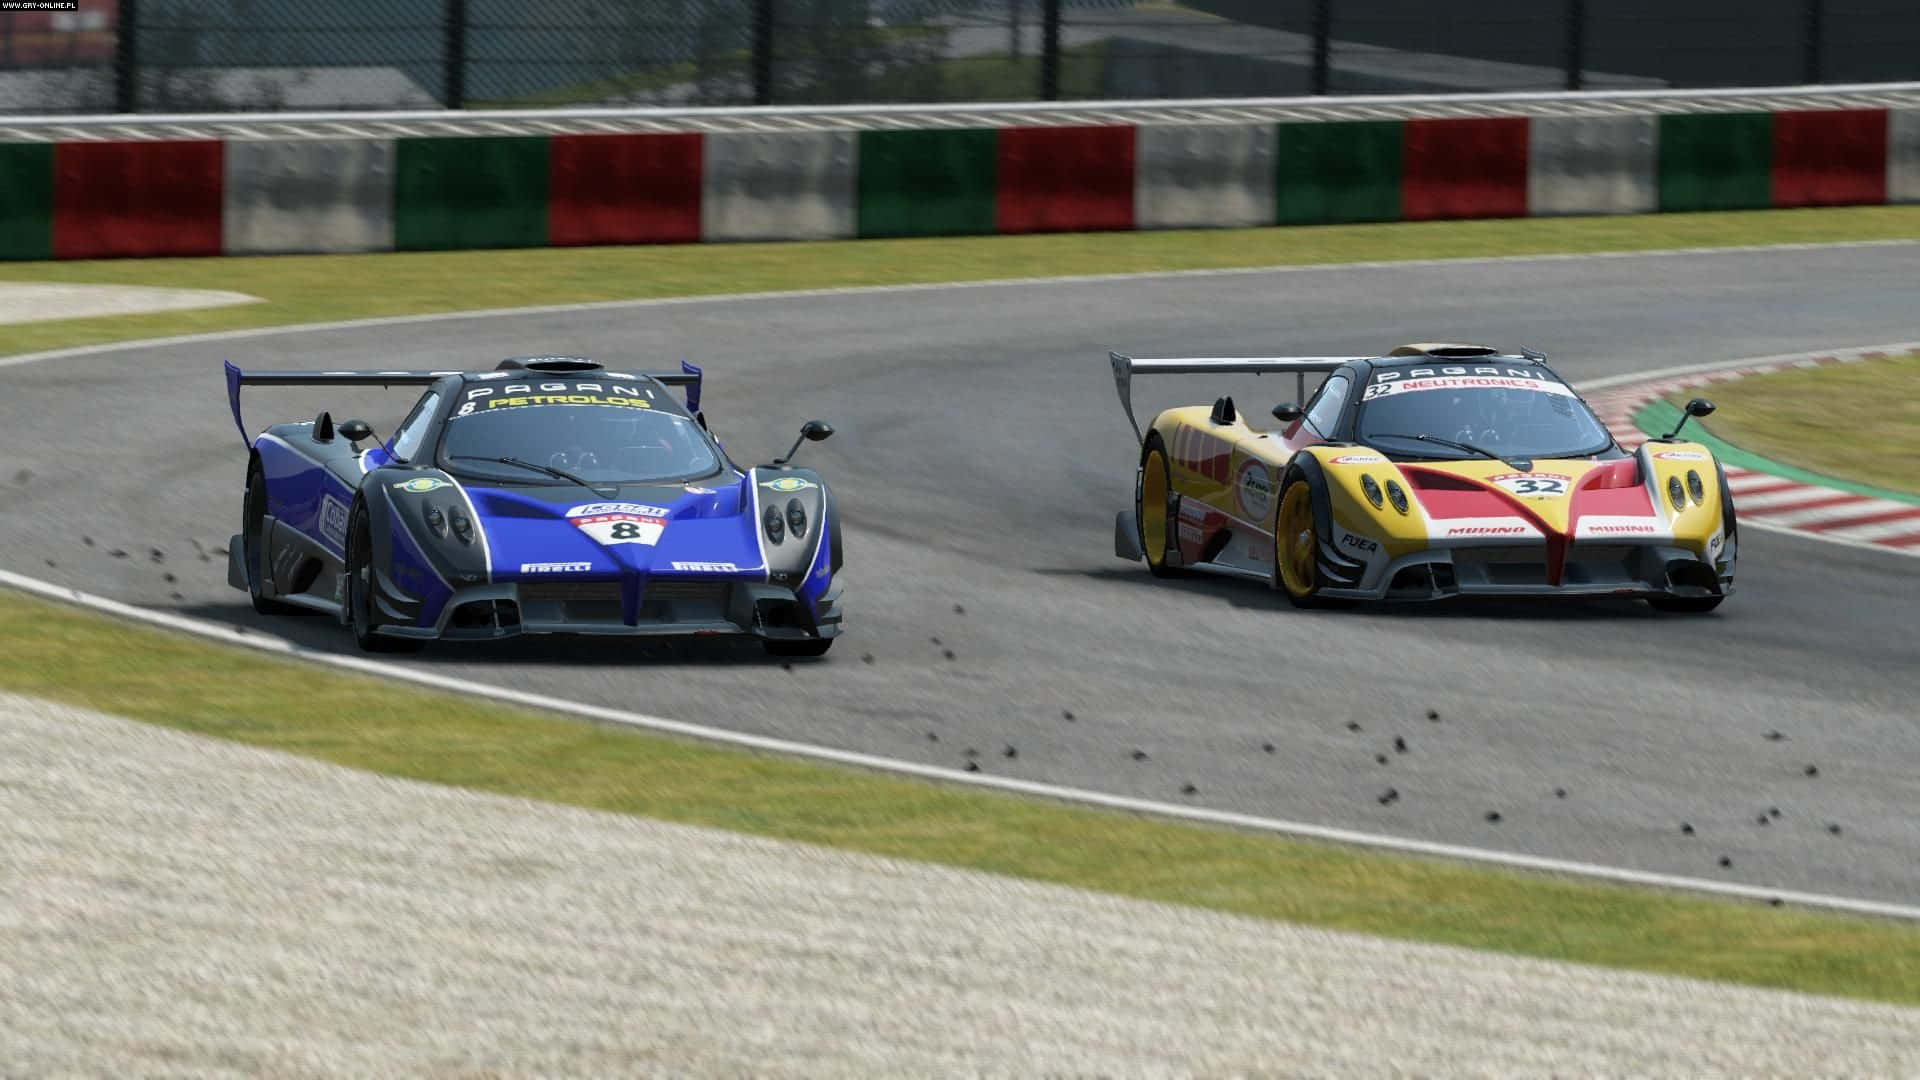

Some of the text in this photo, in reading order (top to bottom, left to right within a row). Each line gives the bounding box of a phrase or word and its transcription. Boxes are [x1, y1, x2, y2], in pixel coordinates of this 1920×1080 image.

[1377, 366, 1545, 384] PAGANI
[467, 383, 655, 400] PAGANI
[1366, 378, 1539, 397] 32 NEUTRONICS
[458, 395, 650, 416] 8 PETROLOS
[1515, 480, 1563, 493] 32
[611, 522, 640, 539] 8
